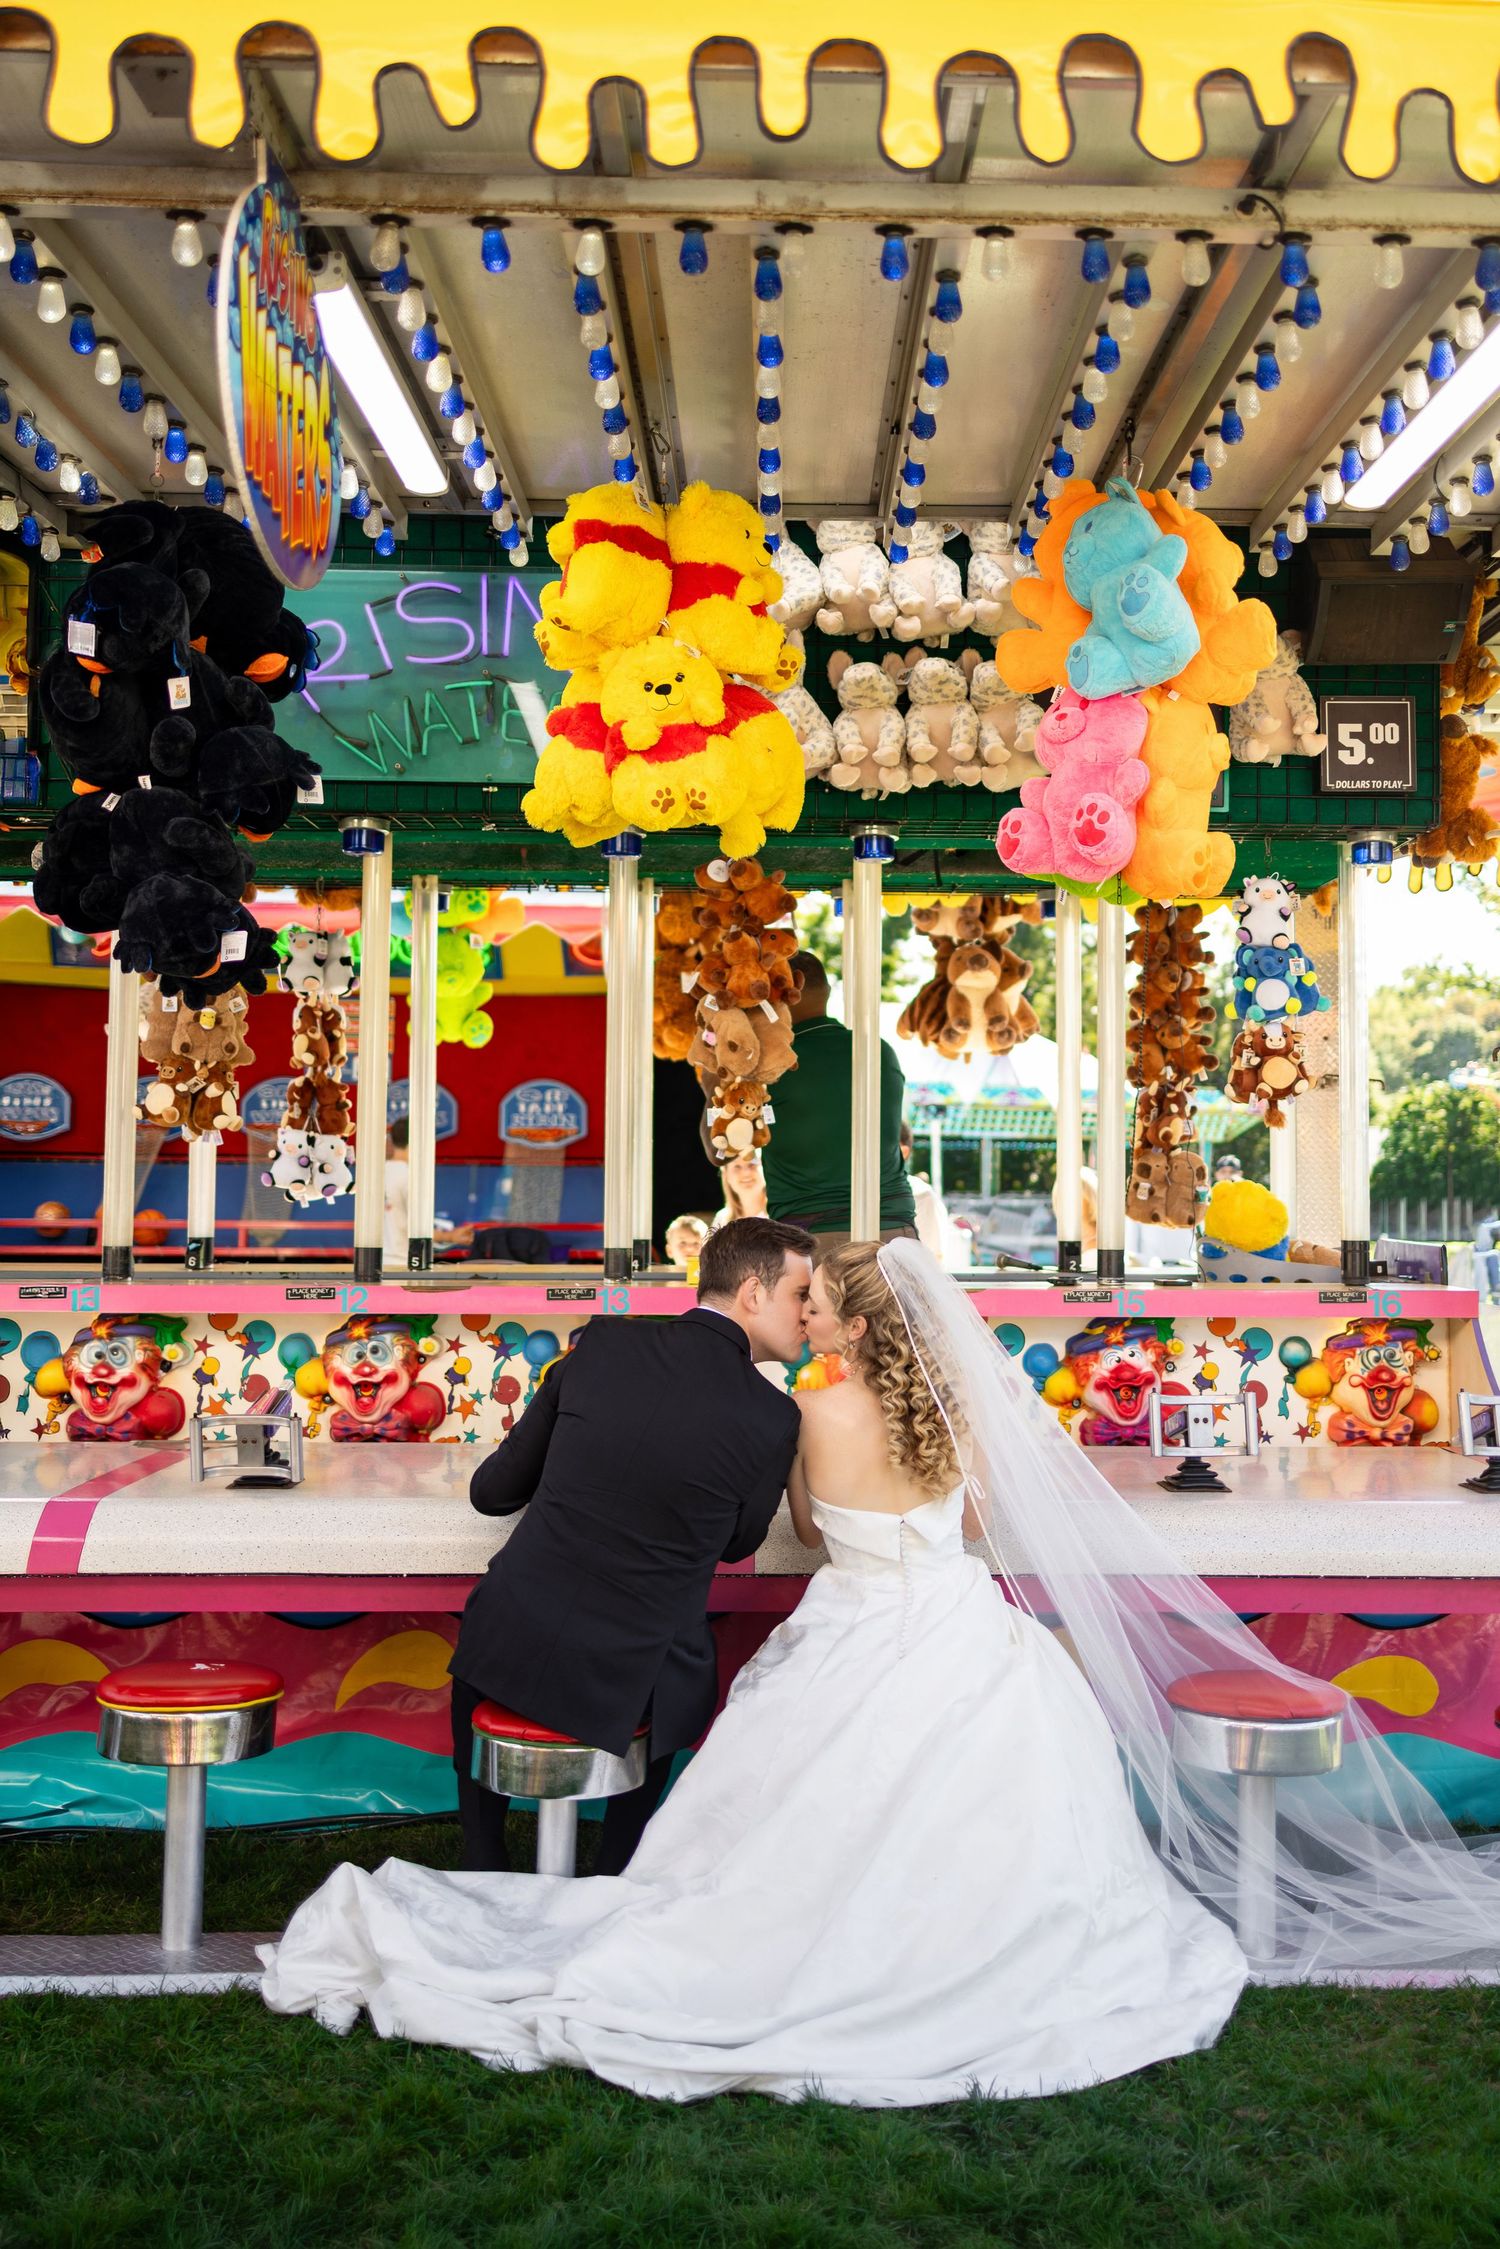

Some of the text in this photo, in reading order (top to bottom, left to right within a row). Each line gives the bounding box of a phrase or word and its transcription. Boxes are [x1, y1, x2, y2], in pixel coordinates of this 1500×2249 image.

[238, 242, 333, 562] WATERS
[1337, 722, 1400, 766] 5.00
[1335, 780, 1403, 789] DOLLARS TO PLAY
[188, 1256, 197, 1267] 6
[411, 1256, 420, 1267] 5
[1069, 1260, 1077, 1271] 2
[336, 1286, 368, 1313] 12
[597, 1287, 631, 1314] 13
[1112, 1290, 1146, 1317] 15
[1368, 1290, 1403, 1317] 16
